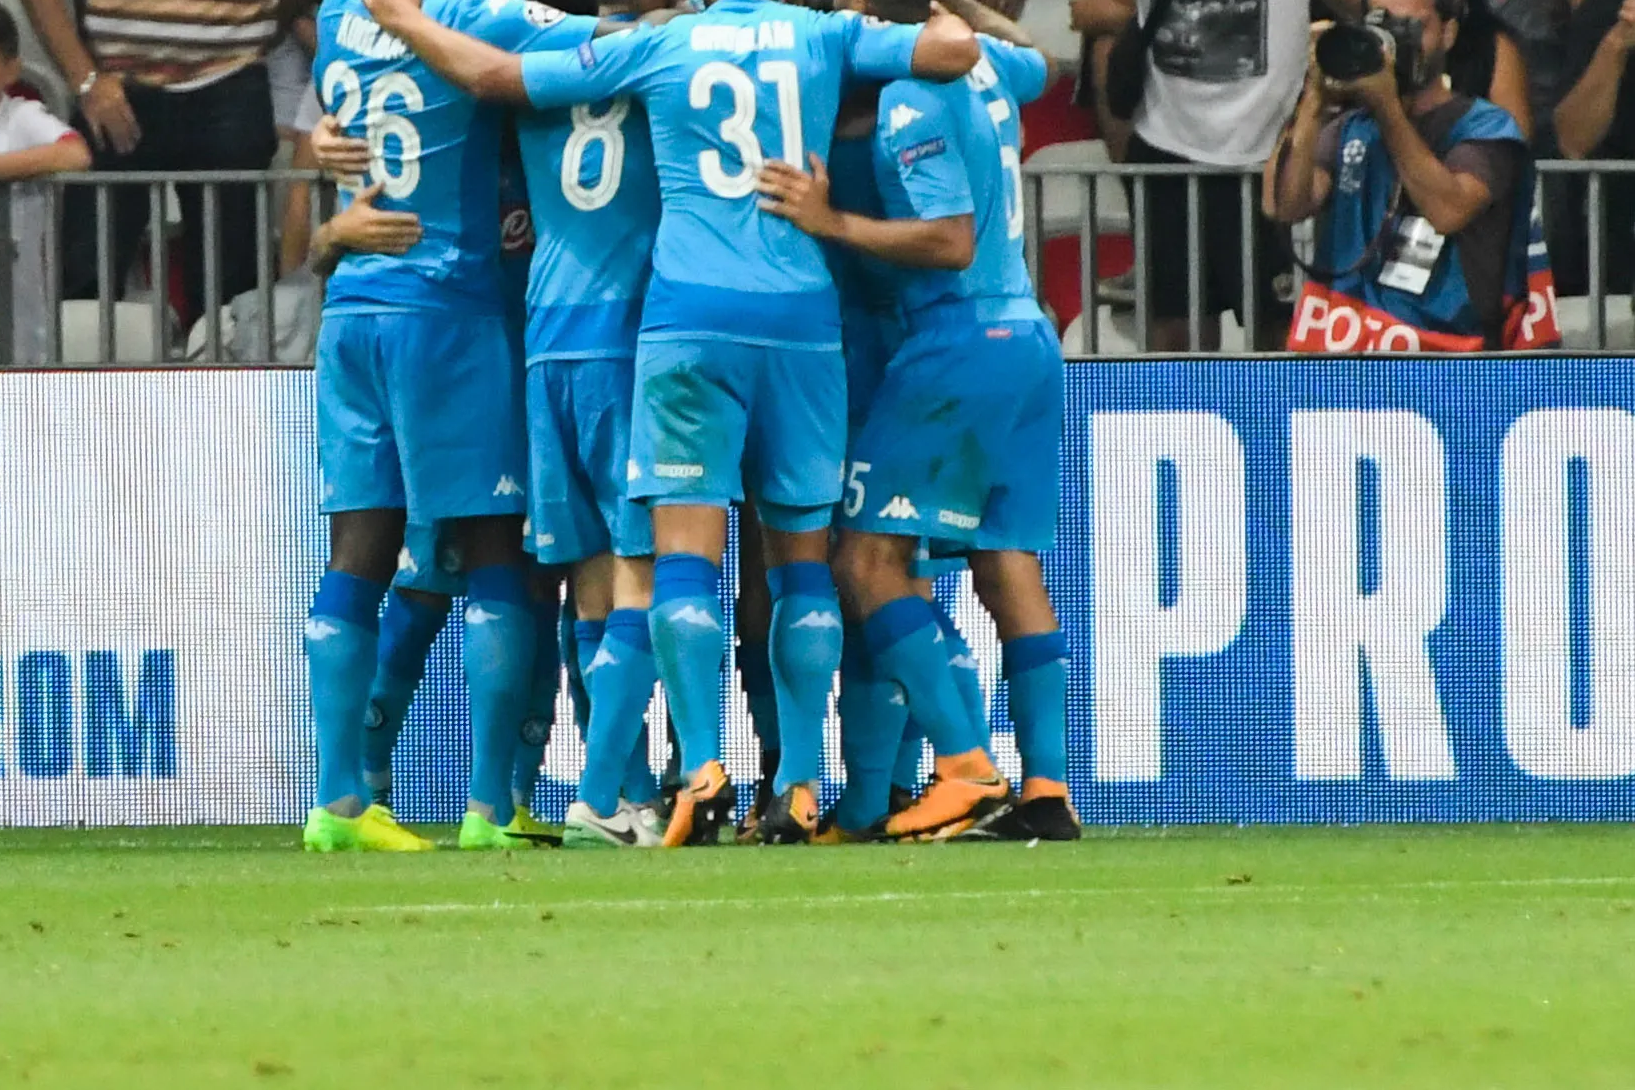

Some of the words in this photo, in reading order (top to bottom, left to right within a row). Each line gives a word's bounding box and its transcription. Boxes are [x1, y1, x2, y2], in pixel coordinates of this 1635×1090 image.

[322, 60, 424, 199] 26
[561, 102, 629, 211] 8
[689, 61, 804, 199] 31
[842, 461, 872, 519] 5
